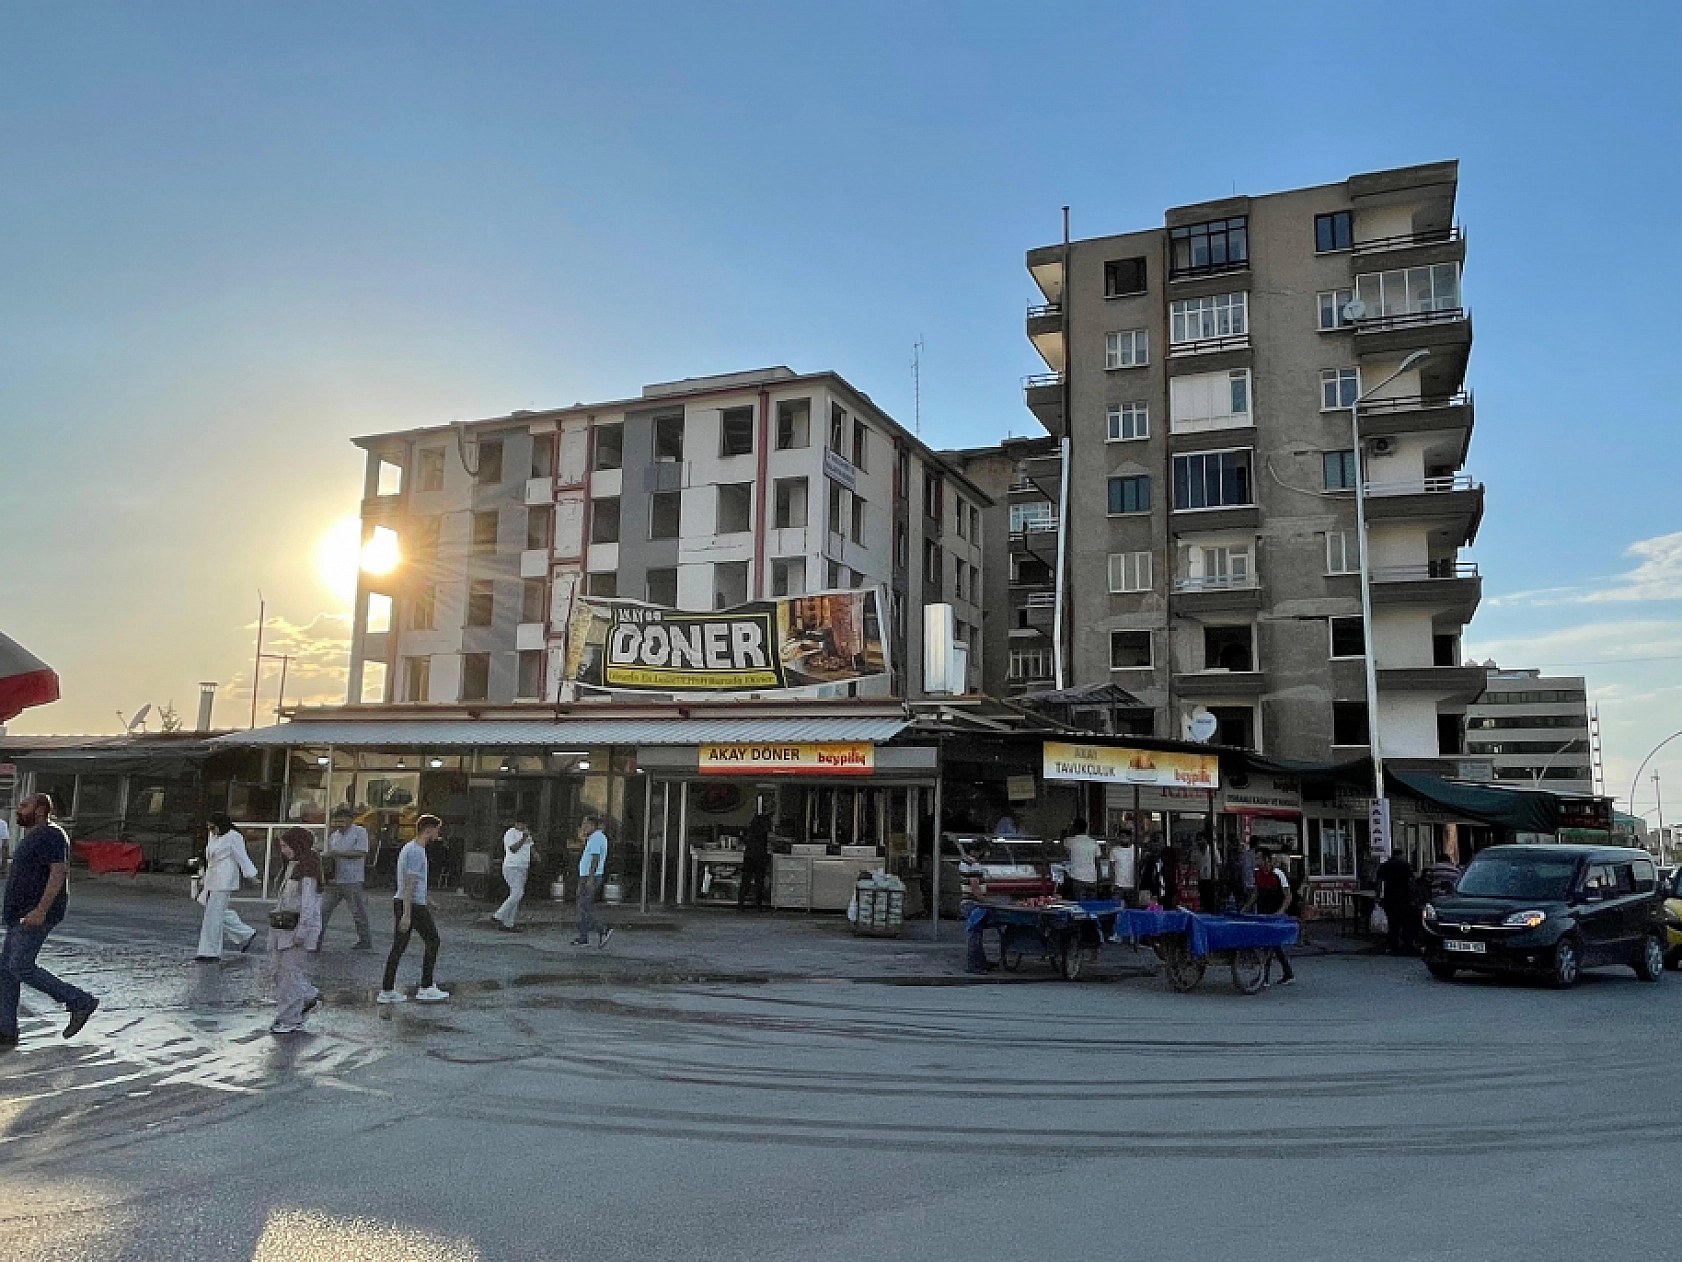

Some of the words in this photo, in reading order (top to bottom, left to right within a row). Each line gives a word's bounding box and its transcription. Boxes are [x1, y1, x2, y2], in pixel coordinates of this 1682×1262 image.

[708, 748, 747, 761] AKAY
[751, 746, 800, 761] DÖNER
[1371, 799, 1383, 844] KASAP
